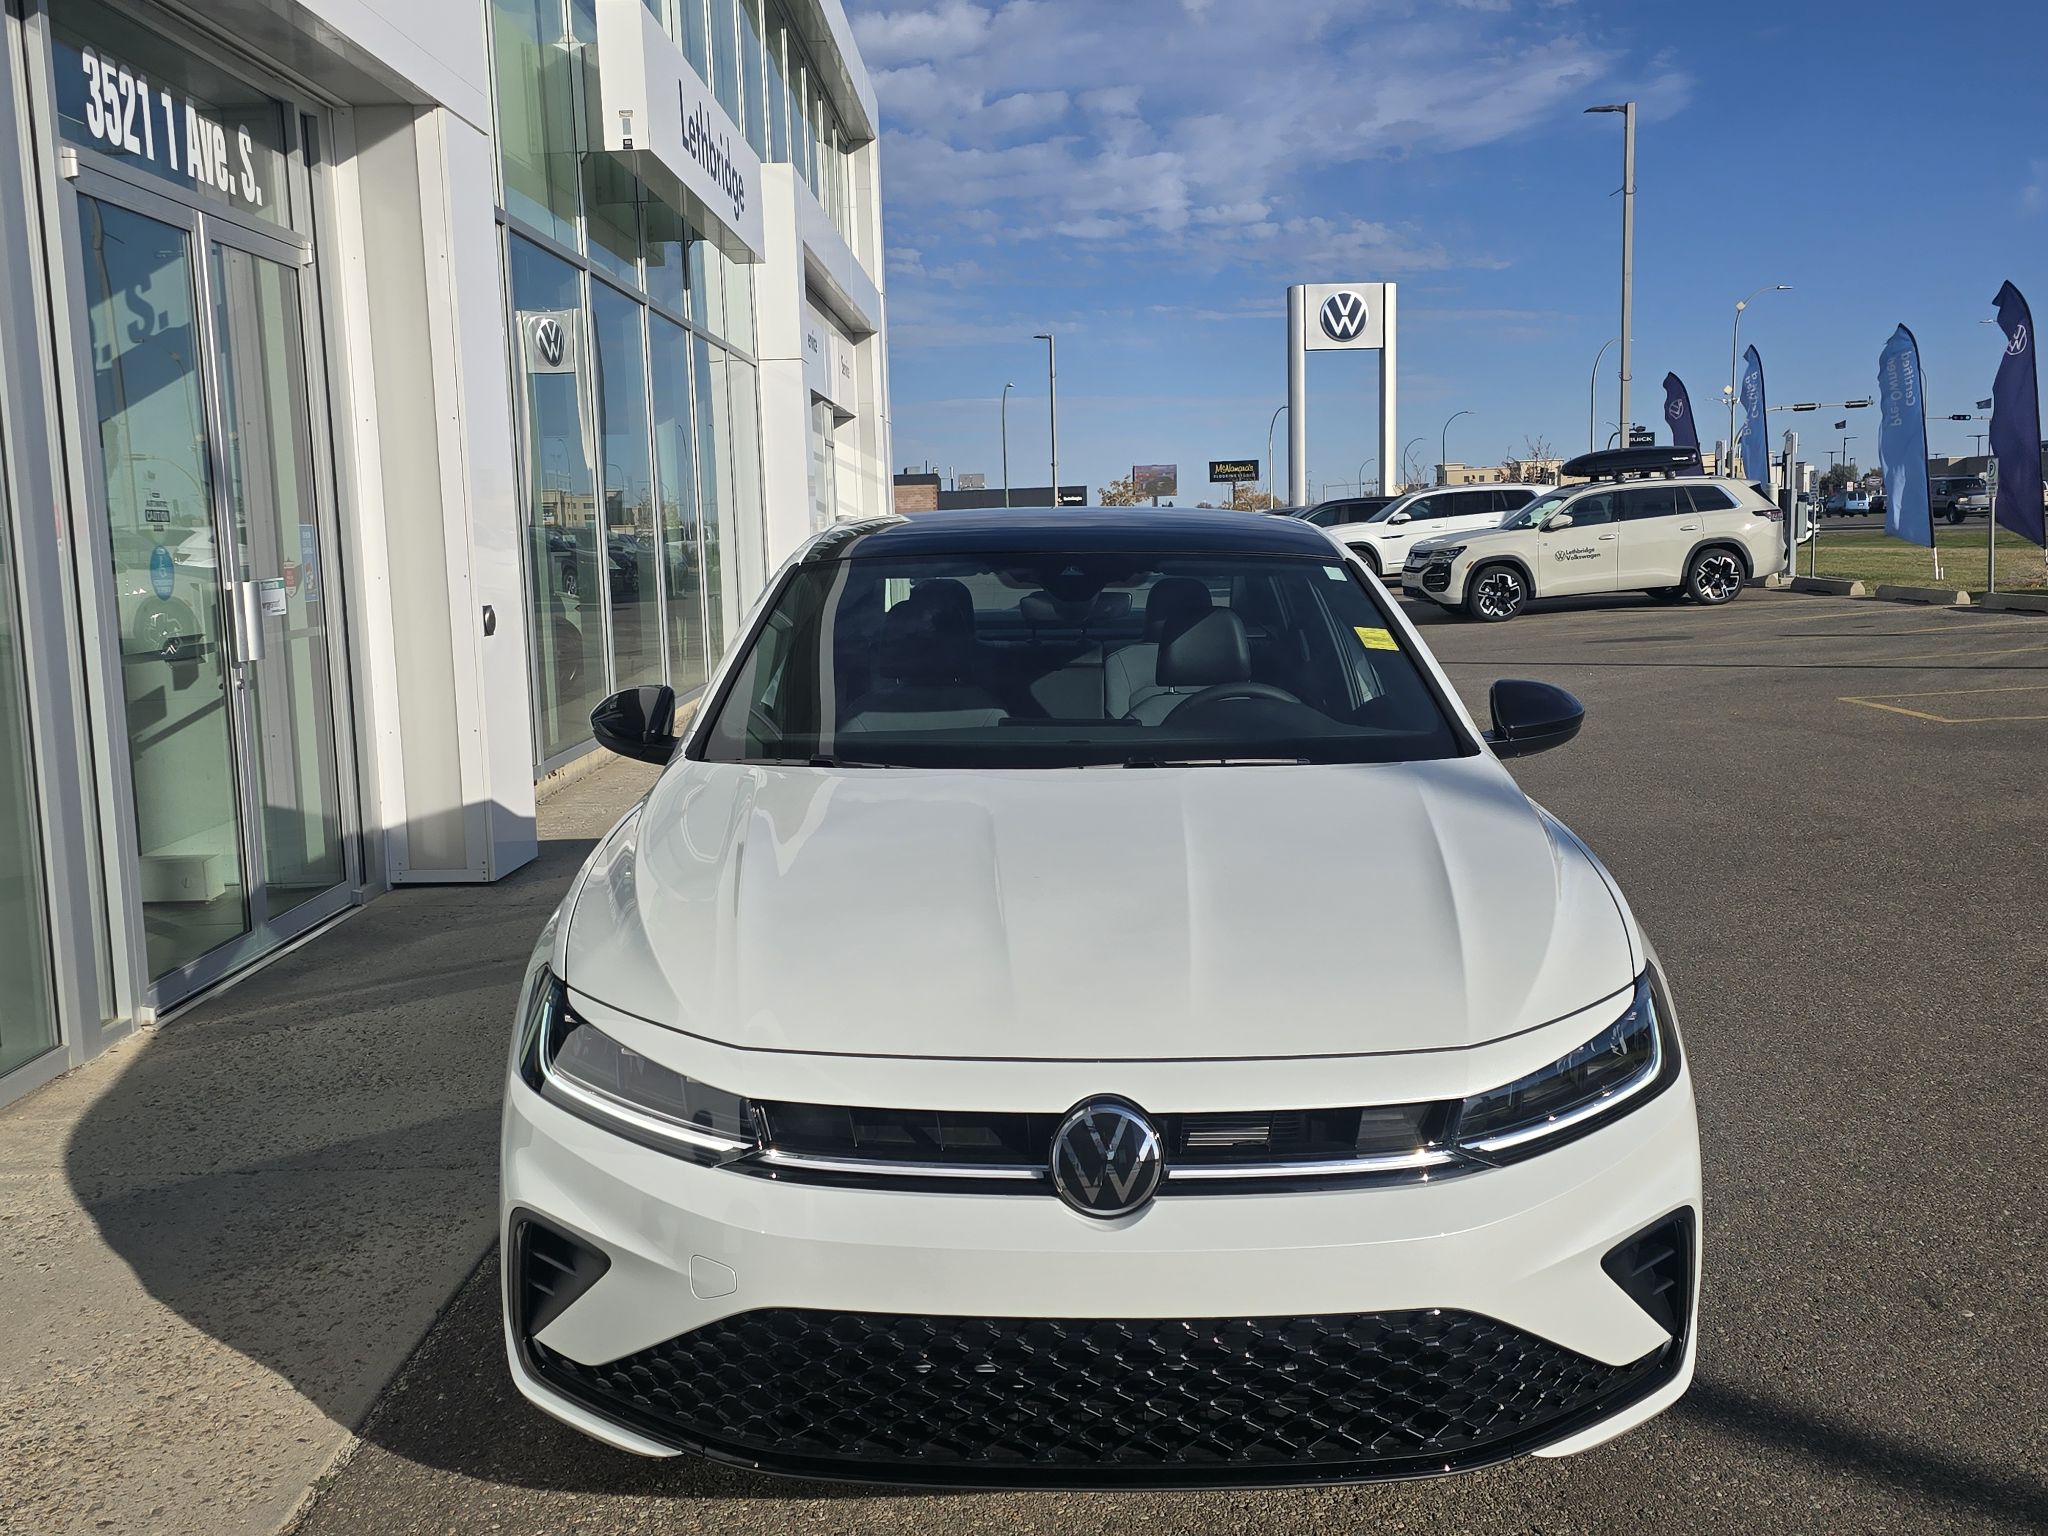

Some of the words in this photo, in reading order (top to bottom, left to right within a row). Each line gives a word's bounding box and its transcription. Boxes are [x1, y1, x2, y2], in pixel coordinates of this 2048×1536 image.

[82, 46, 155, 161] 3521
[160, 87, 179, 171] 1
[237, 124, 263, 206] S.
[678, 78, 745, 222] Lethbridge
[1566, 547, 1595, 555] Lethbridge
[1566, 553, 1601, 561] Volkswagen
